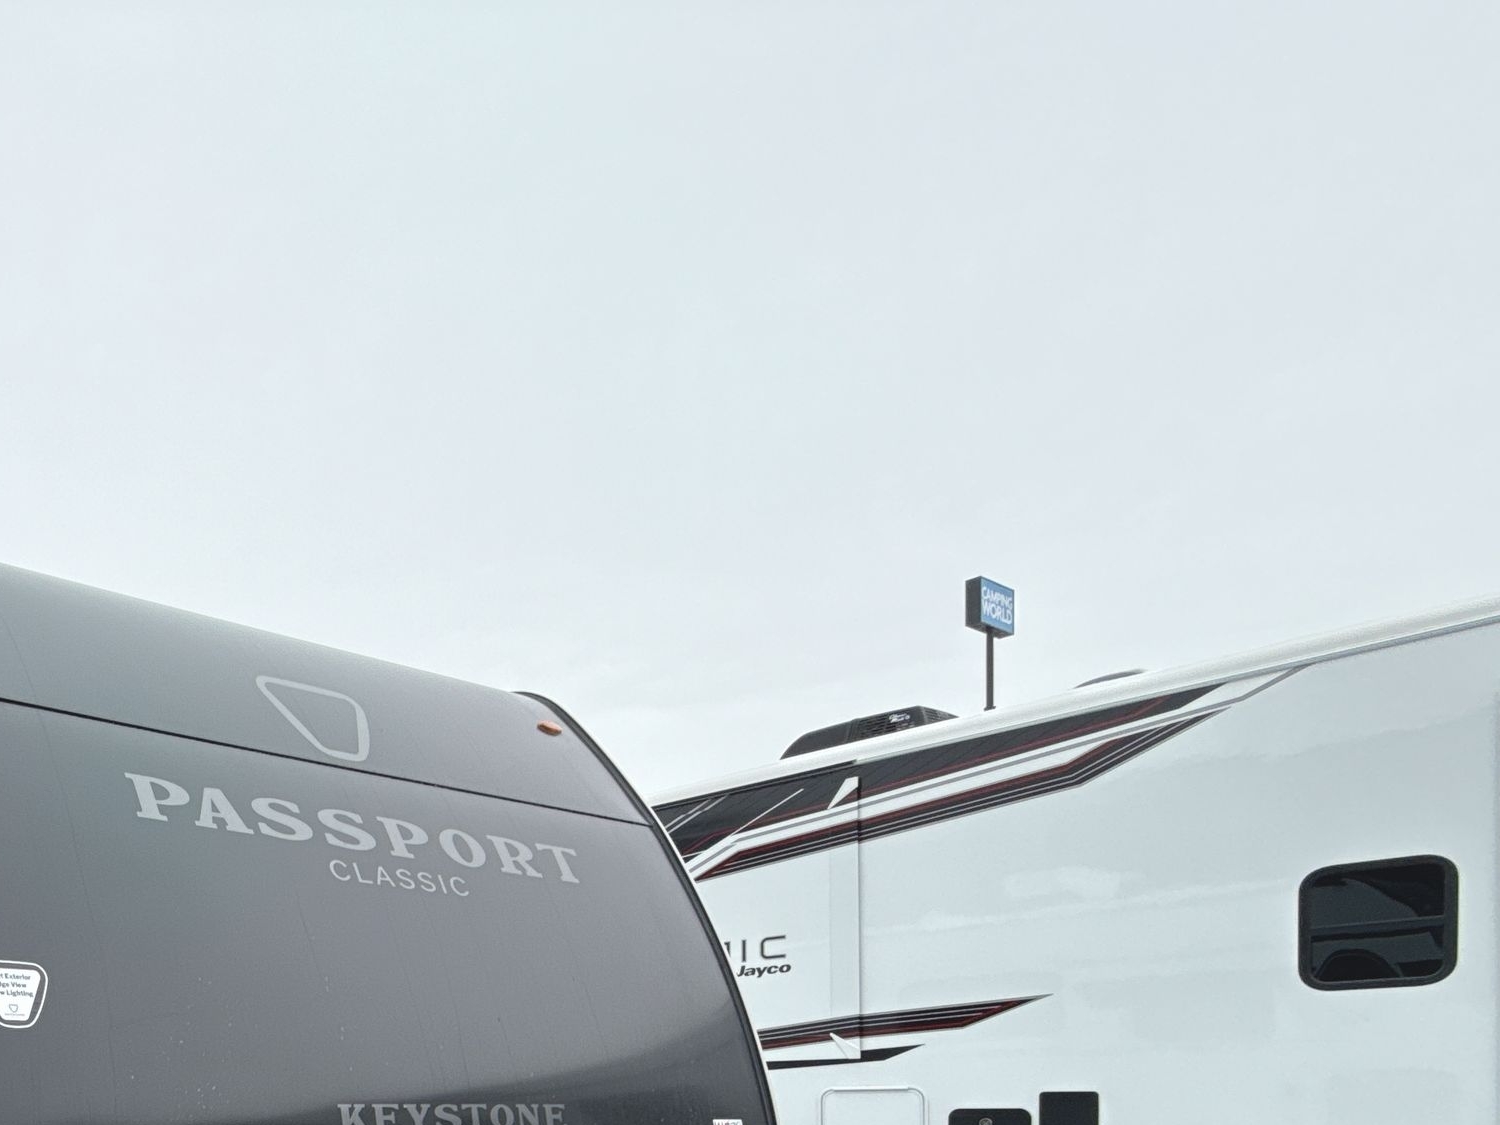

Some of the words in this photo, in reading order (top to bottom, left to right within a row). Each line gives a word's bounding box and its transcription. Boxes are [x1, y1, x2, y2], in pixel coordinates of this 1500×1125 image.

[981, 586, 1012, 610] CAMPING
[981, 599, 1012, 625] WORLD
[124, 772, 581, 884] PASSPORT
[328, 859, 471, 898] CLASSIC
[4, 972, 32, 981] Exterior
[736, 963, 792, 979] Jayco
[6, 989, 34, 998] Lighting
[10, 981, 27, 989] View
